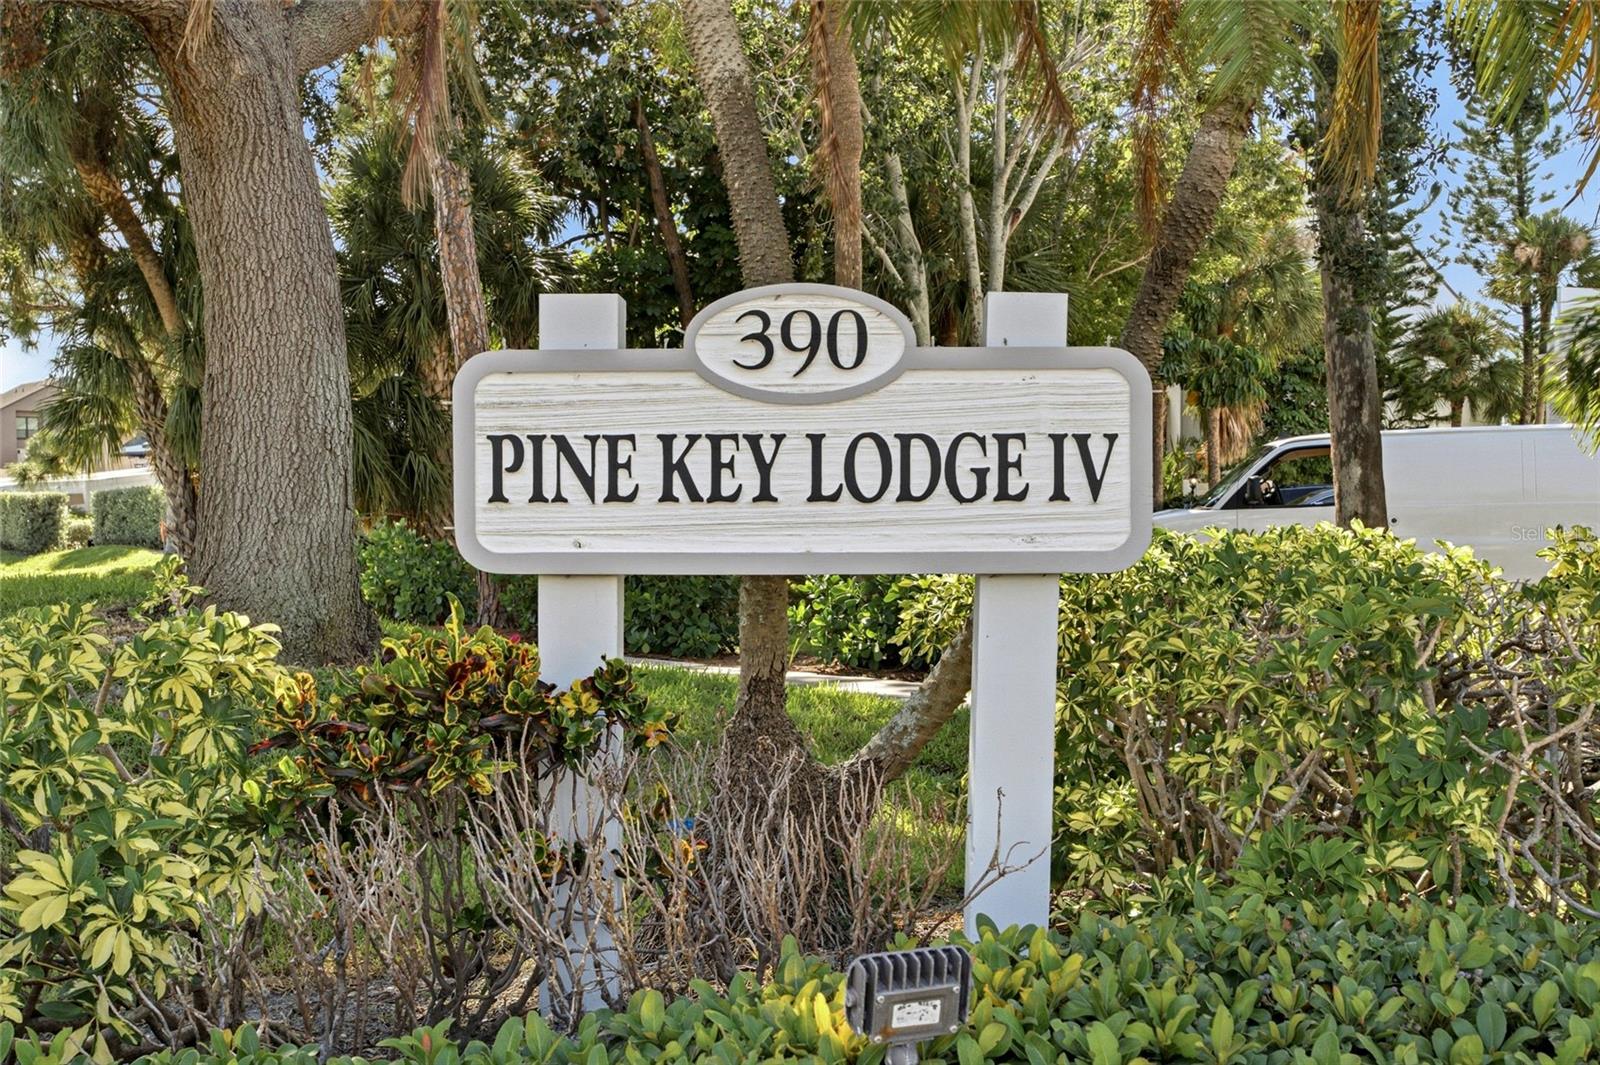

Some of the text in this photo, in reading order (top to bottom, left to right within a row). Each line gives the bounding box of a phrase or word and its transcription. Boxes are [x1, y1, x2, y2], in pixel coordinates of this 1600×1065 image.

[732, 309, 868, 379] 390
[486, 432, 1119, 505] PINE KEY LODGE IV
